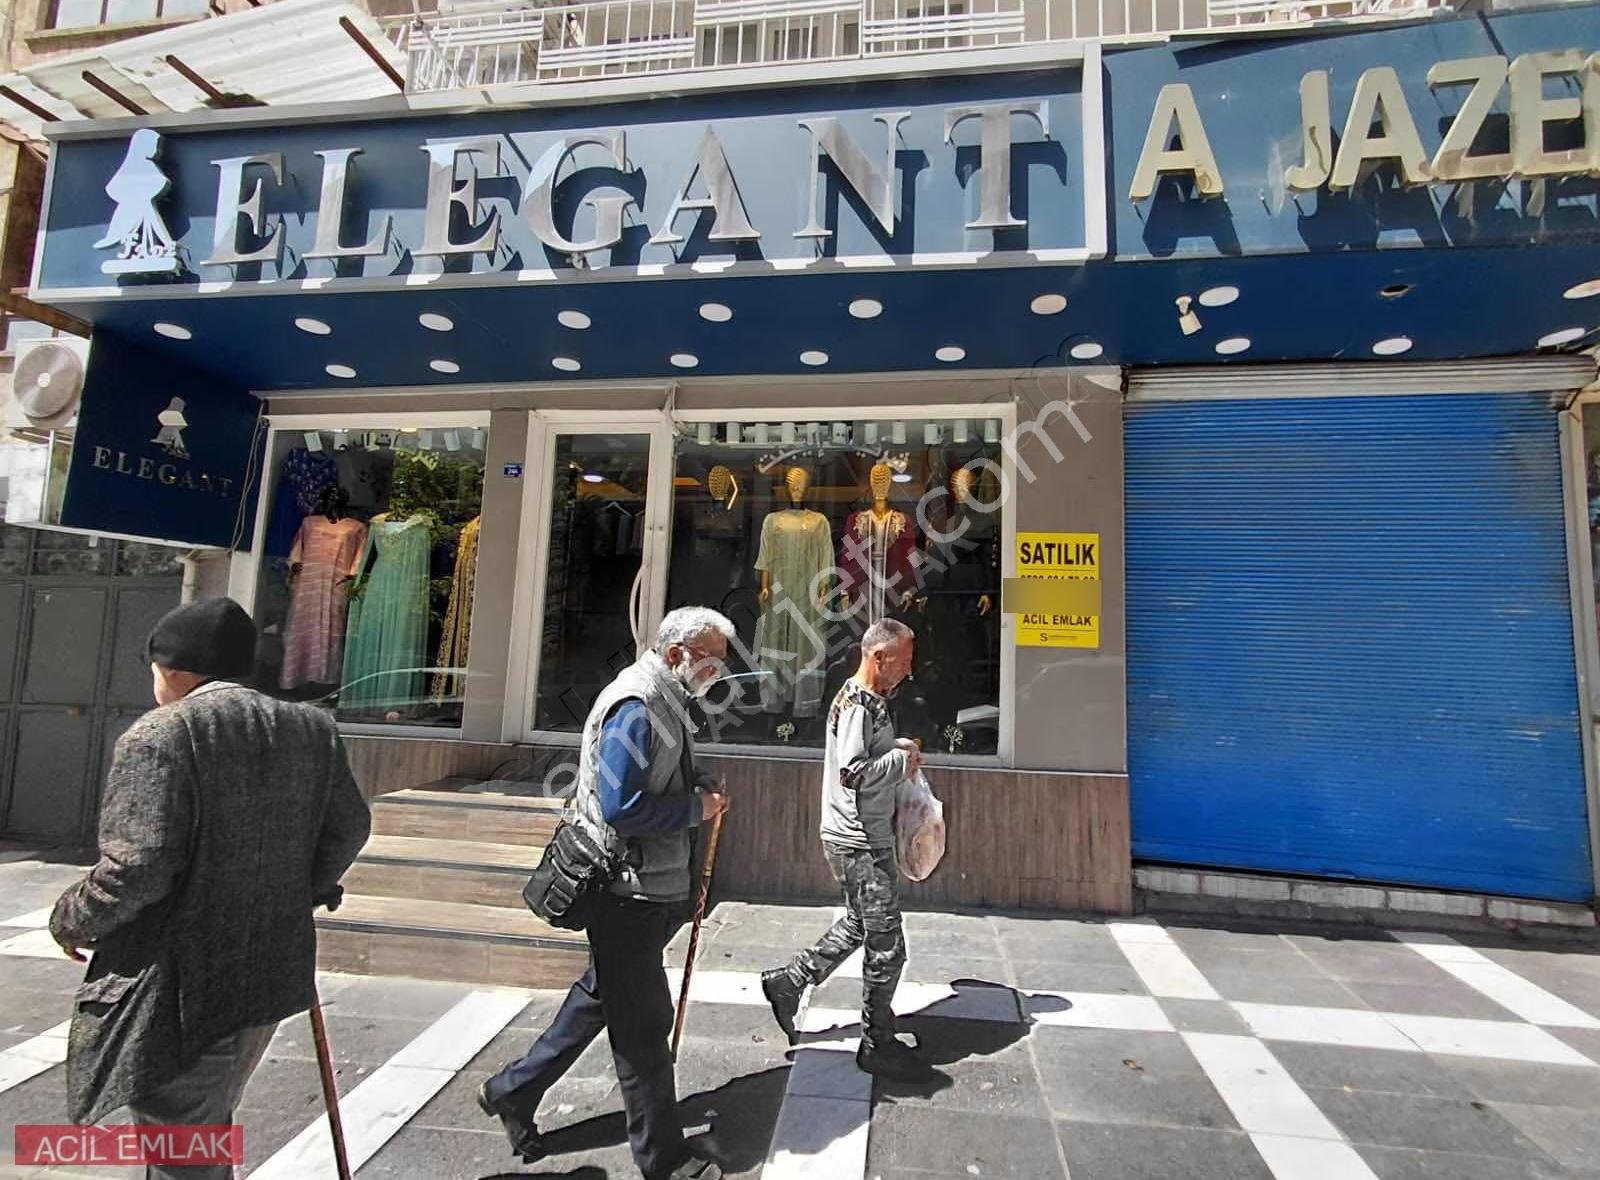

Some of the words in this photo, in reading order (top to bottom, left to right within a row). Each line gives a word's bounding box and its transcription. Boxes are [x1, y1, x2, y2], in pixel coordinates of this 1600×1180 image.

[1129, 83, 1224, 200] A
[200, 100, 1051, 266] ELEGANT
[93, 445, 233, 498] ELEGANT
[1020, 542, 1095, 565] SATILIK
[1052, 614, 1092, 626] EMLAK
